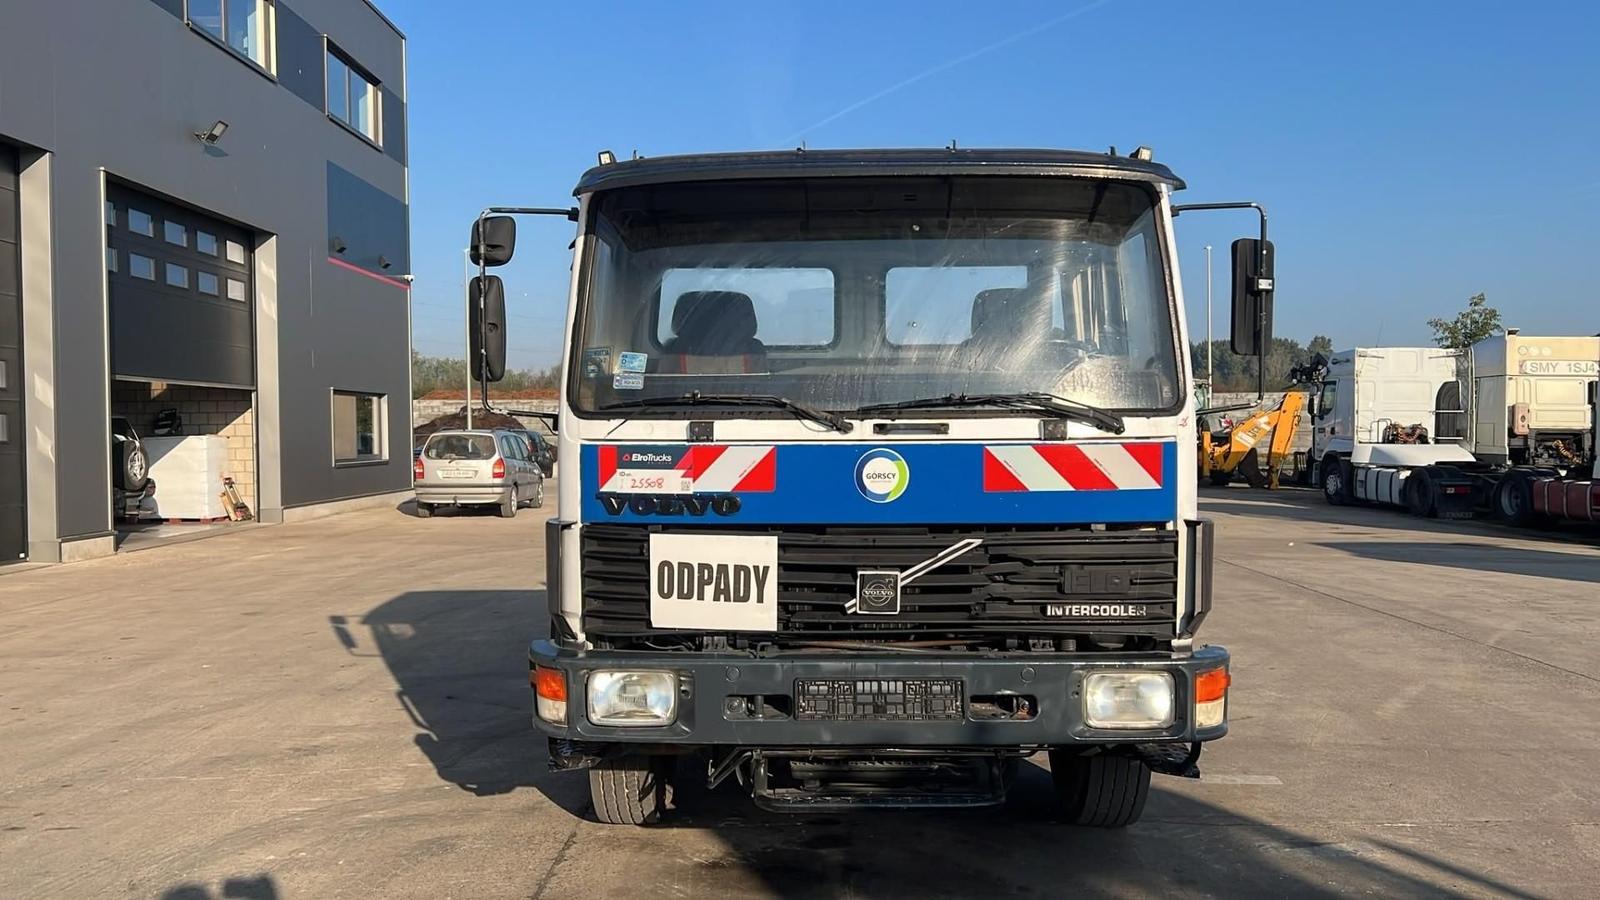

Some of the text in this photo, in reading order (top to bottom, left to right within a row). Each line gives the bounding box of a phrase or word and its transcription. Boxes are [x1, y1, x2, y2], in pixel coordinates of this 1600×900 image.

[1530, 362, 1558, 373] SMY
[631, 453, 672, 462] ElroTrucks
[631, 478, 665, 489] 25508
[595, 491, 741, 516] VOLVO
[657, 560, 770, 604] ODPADY
